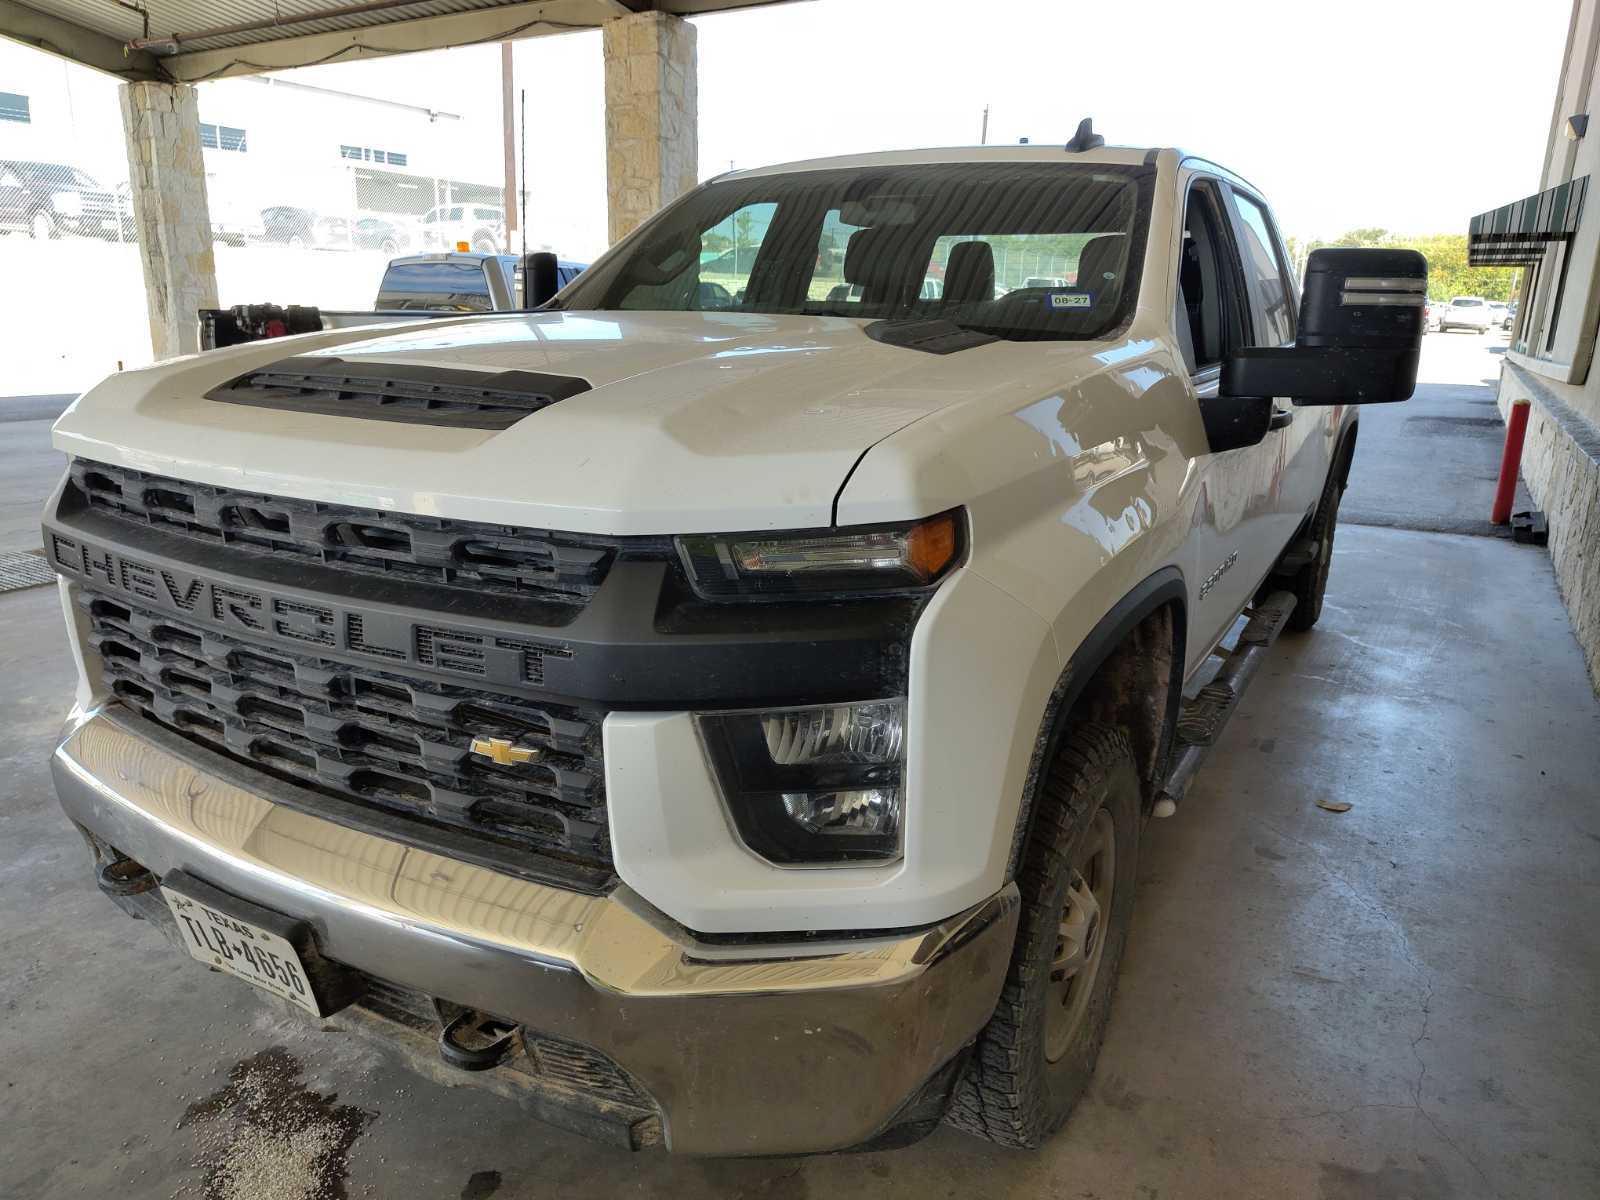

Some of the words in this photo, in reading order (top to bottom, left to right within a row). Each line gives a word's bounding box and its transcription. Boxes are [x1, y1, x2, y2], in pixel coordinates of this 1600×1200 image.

[1054, 296, 1088, 304] 08-27
[52, 533, 574, 686] CHEVROLET
[201, 907, 254, 939] TEXAS
